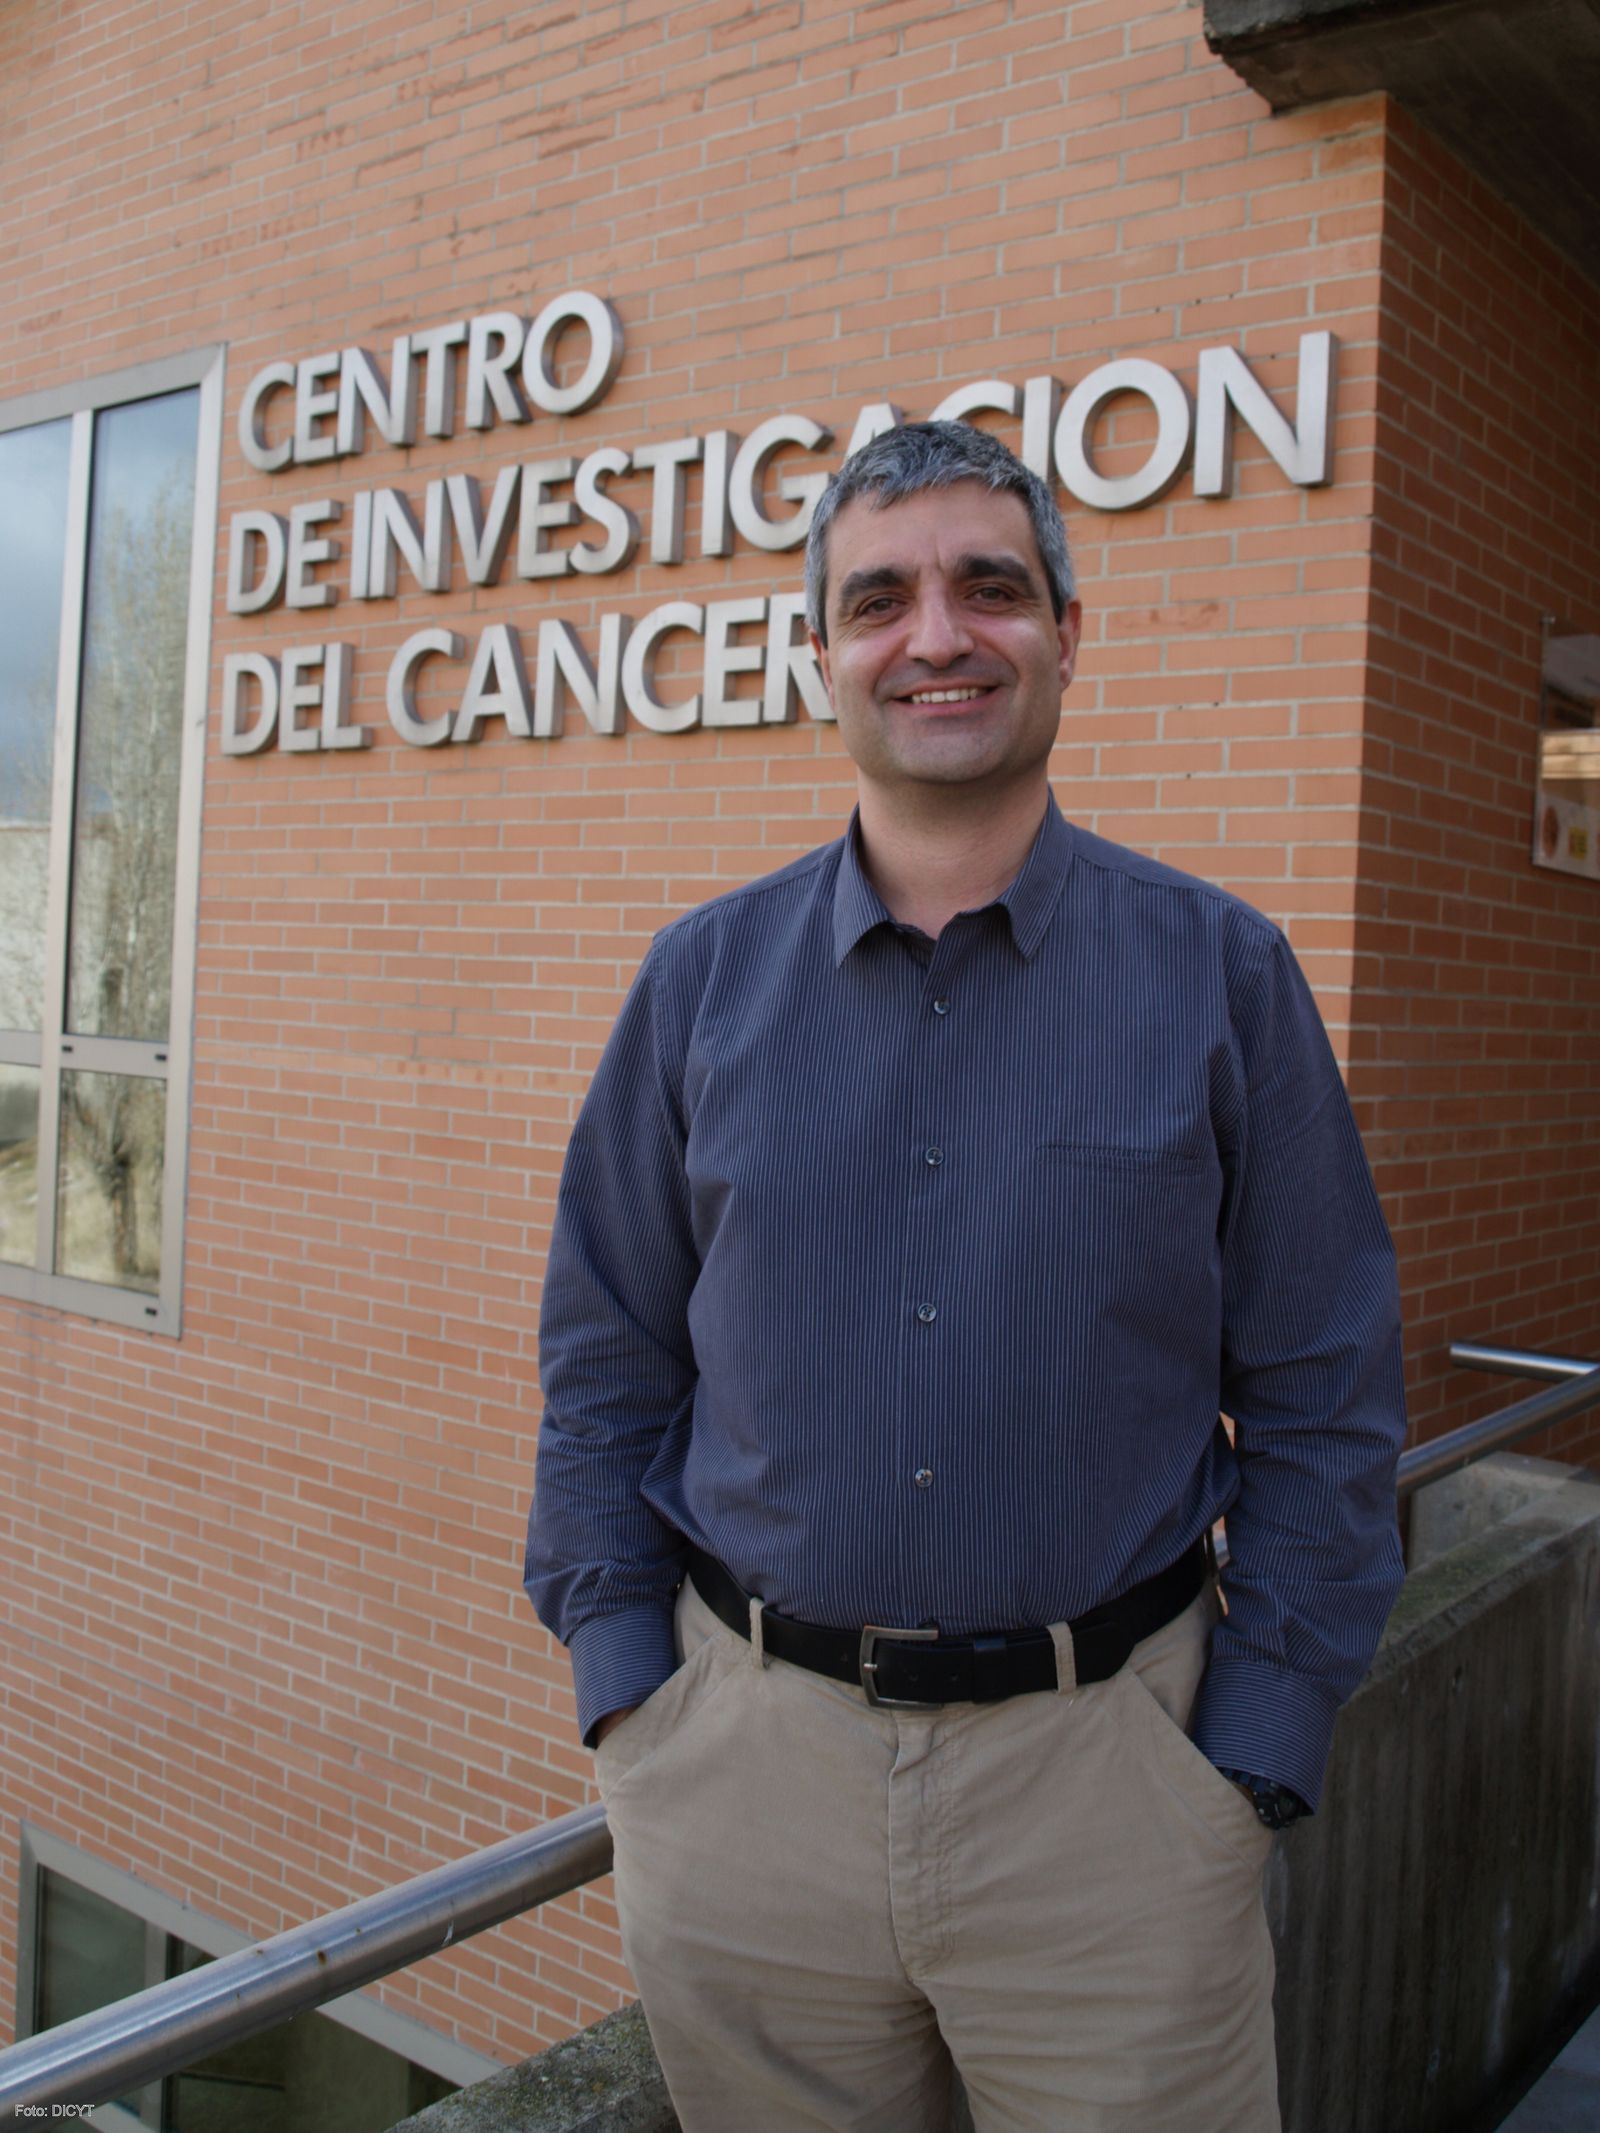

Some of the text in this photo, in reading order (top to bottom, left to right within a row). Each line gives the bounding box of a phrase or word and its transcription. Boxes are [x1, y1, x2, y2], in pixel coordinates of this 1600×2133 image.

[238, 290, 623, 472] CENTRO
[226, 500, 341, 615] DE
[220, 592, 838, 756] DEL CANCER
